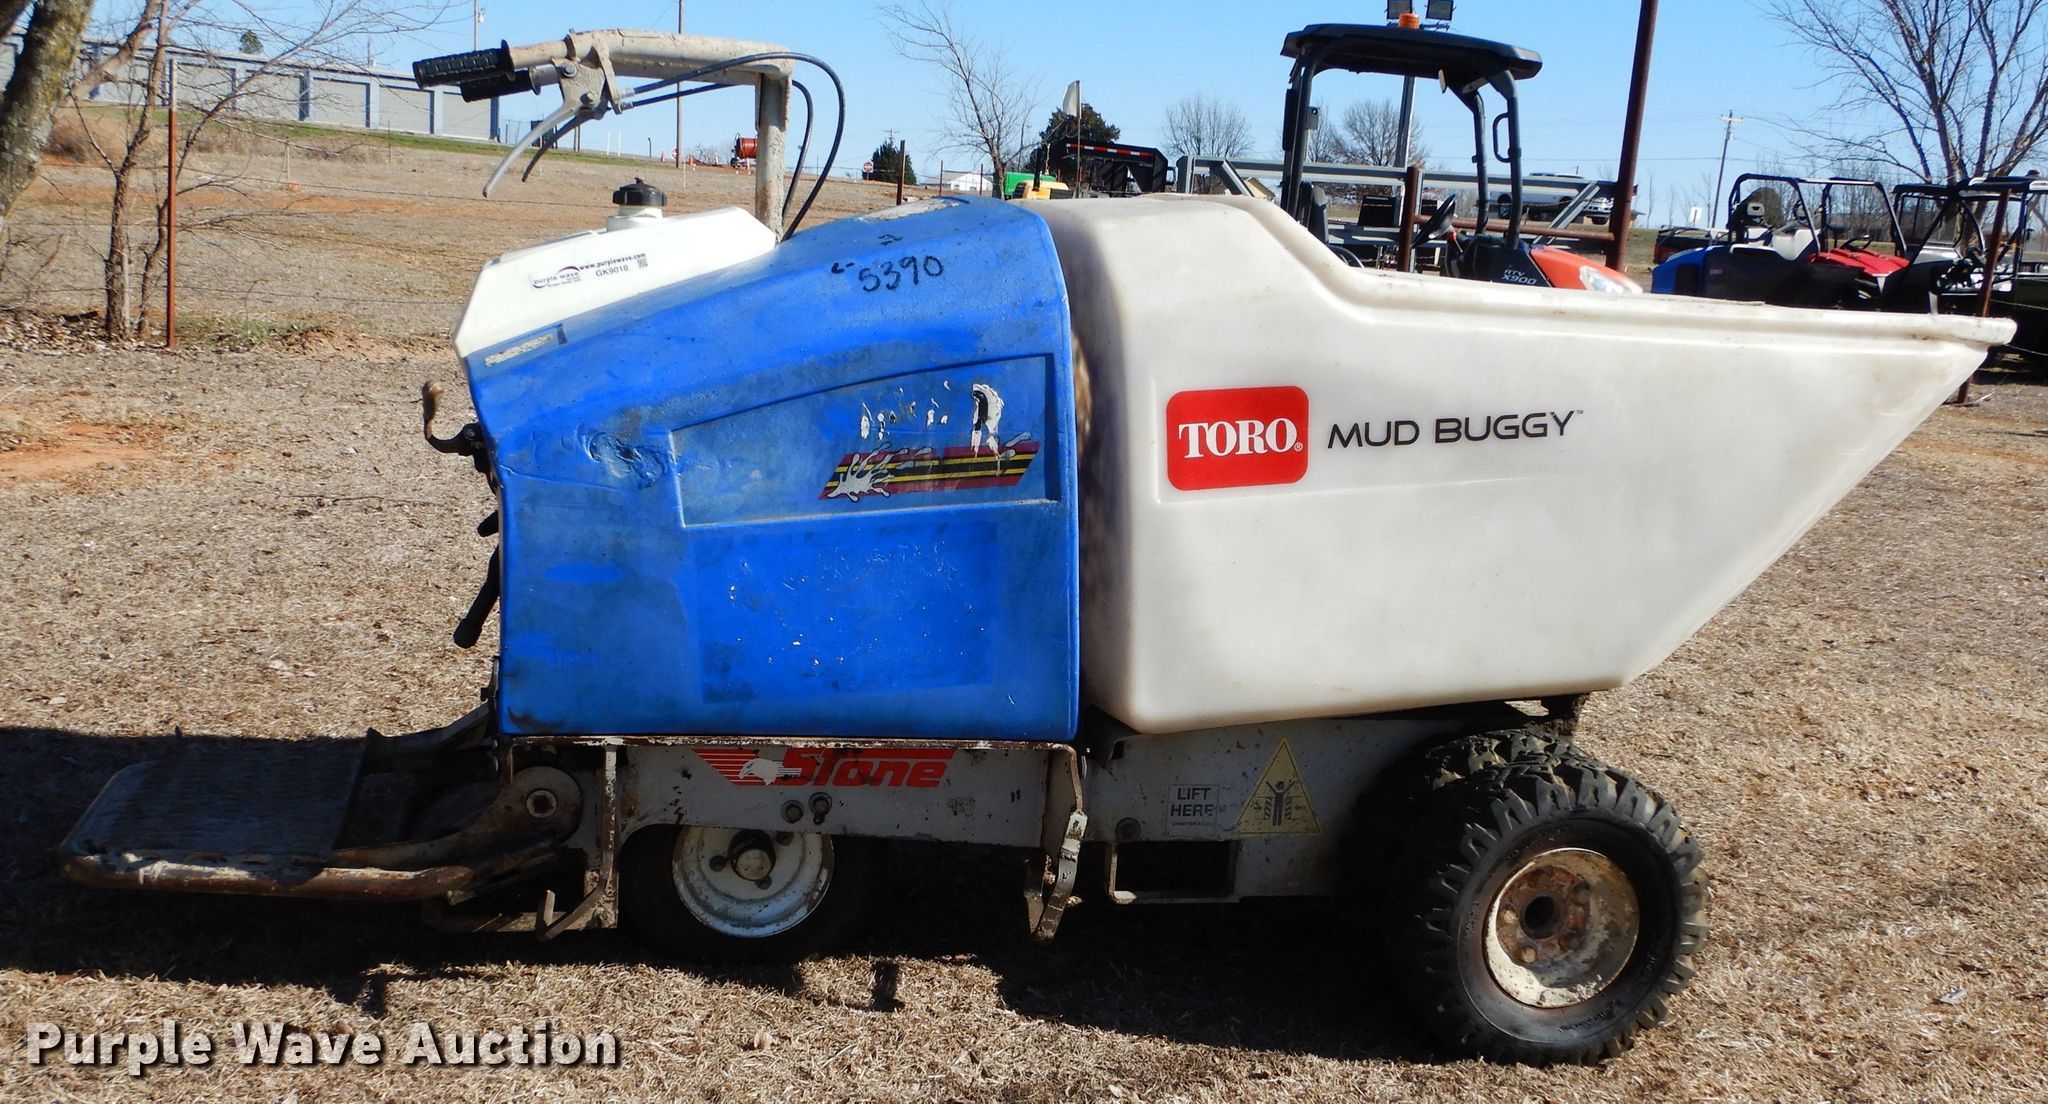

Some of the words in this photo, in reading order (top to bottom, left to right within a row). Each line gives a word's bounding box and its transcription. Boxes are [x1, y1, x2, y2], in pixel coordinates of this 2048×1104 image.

[579, 252, 646, 270] www.purplewave.com
[533, 275, 557, 285] purple
[559, 271, 579, 279] wave
[858, 255, 944, 292] 5390
[1502, 274, 1537, 284] X900
[1327, 420, 1420, 449] MUD
[1435, 410, 1575, 444] BUGGY
[1177, 787, 1211, 801] LIFT
[1170, 804, 1214, 817] HERE
